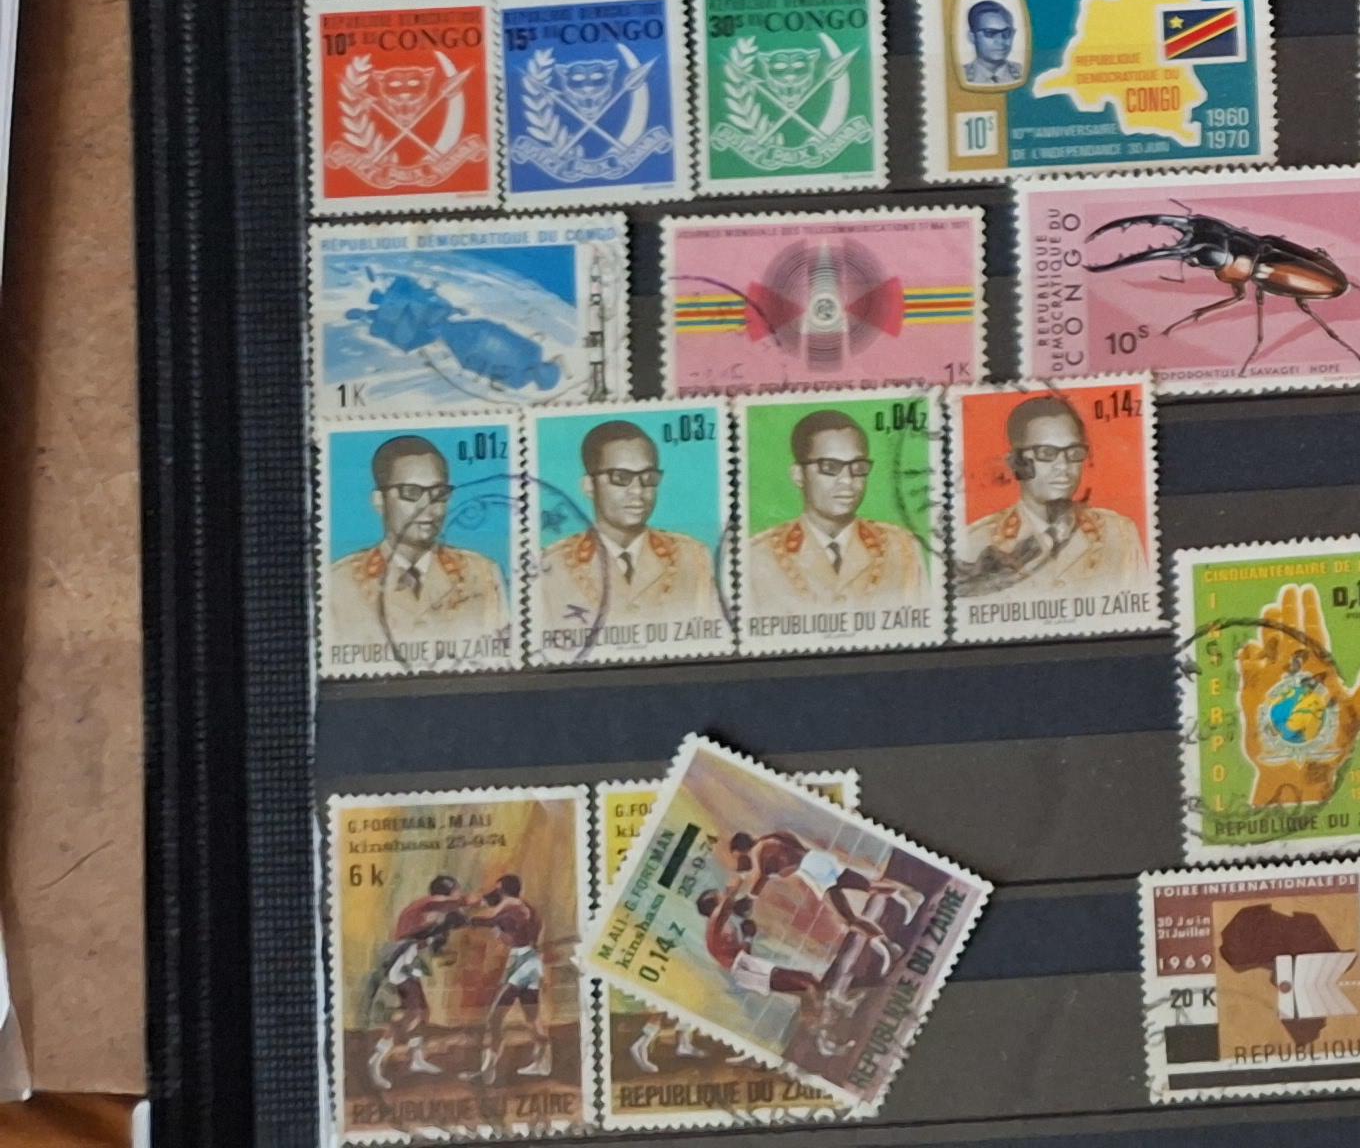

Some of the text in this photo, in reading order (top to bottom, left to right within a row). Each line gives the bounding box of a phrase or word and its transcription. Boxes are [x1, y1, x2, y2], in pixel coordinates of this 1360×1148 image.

[560, 19, 663, 44] CONGO
[764, 9, 868, 33] CONGO
[378, 28, 482, 48] CONGO
[1126, 86, 1180, 113] CONGO
[1206, 108, 1249, 127] 1960
[1206, 130, 1249, 150] 1970
[1062, 213, 1085, 367] CONGO
[969, 600, 1063, 622] REPUBLIQUE
[1067, 598, 1093, 618] DU
[748, 613, 847, 637] REPUBLIQUE
[853, 610, 876, 631] DU
[348, 867, 364, 887] 6
[1170, 987, 1216, 1009] 20 K
